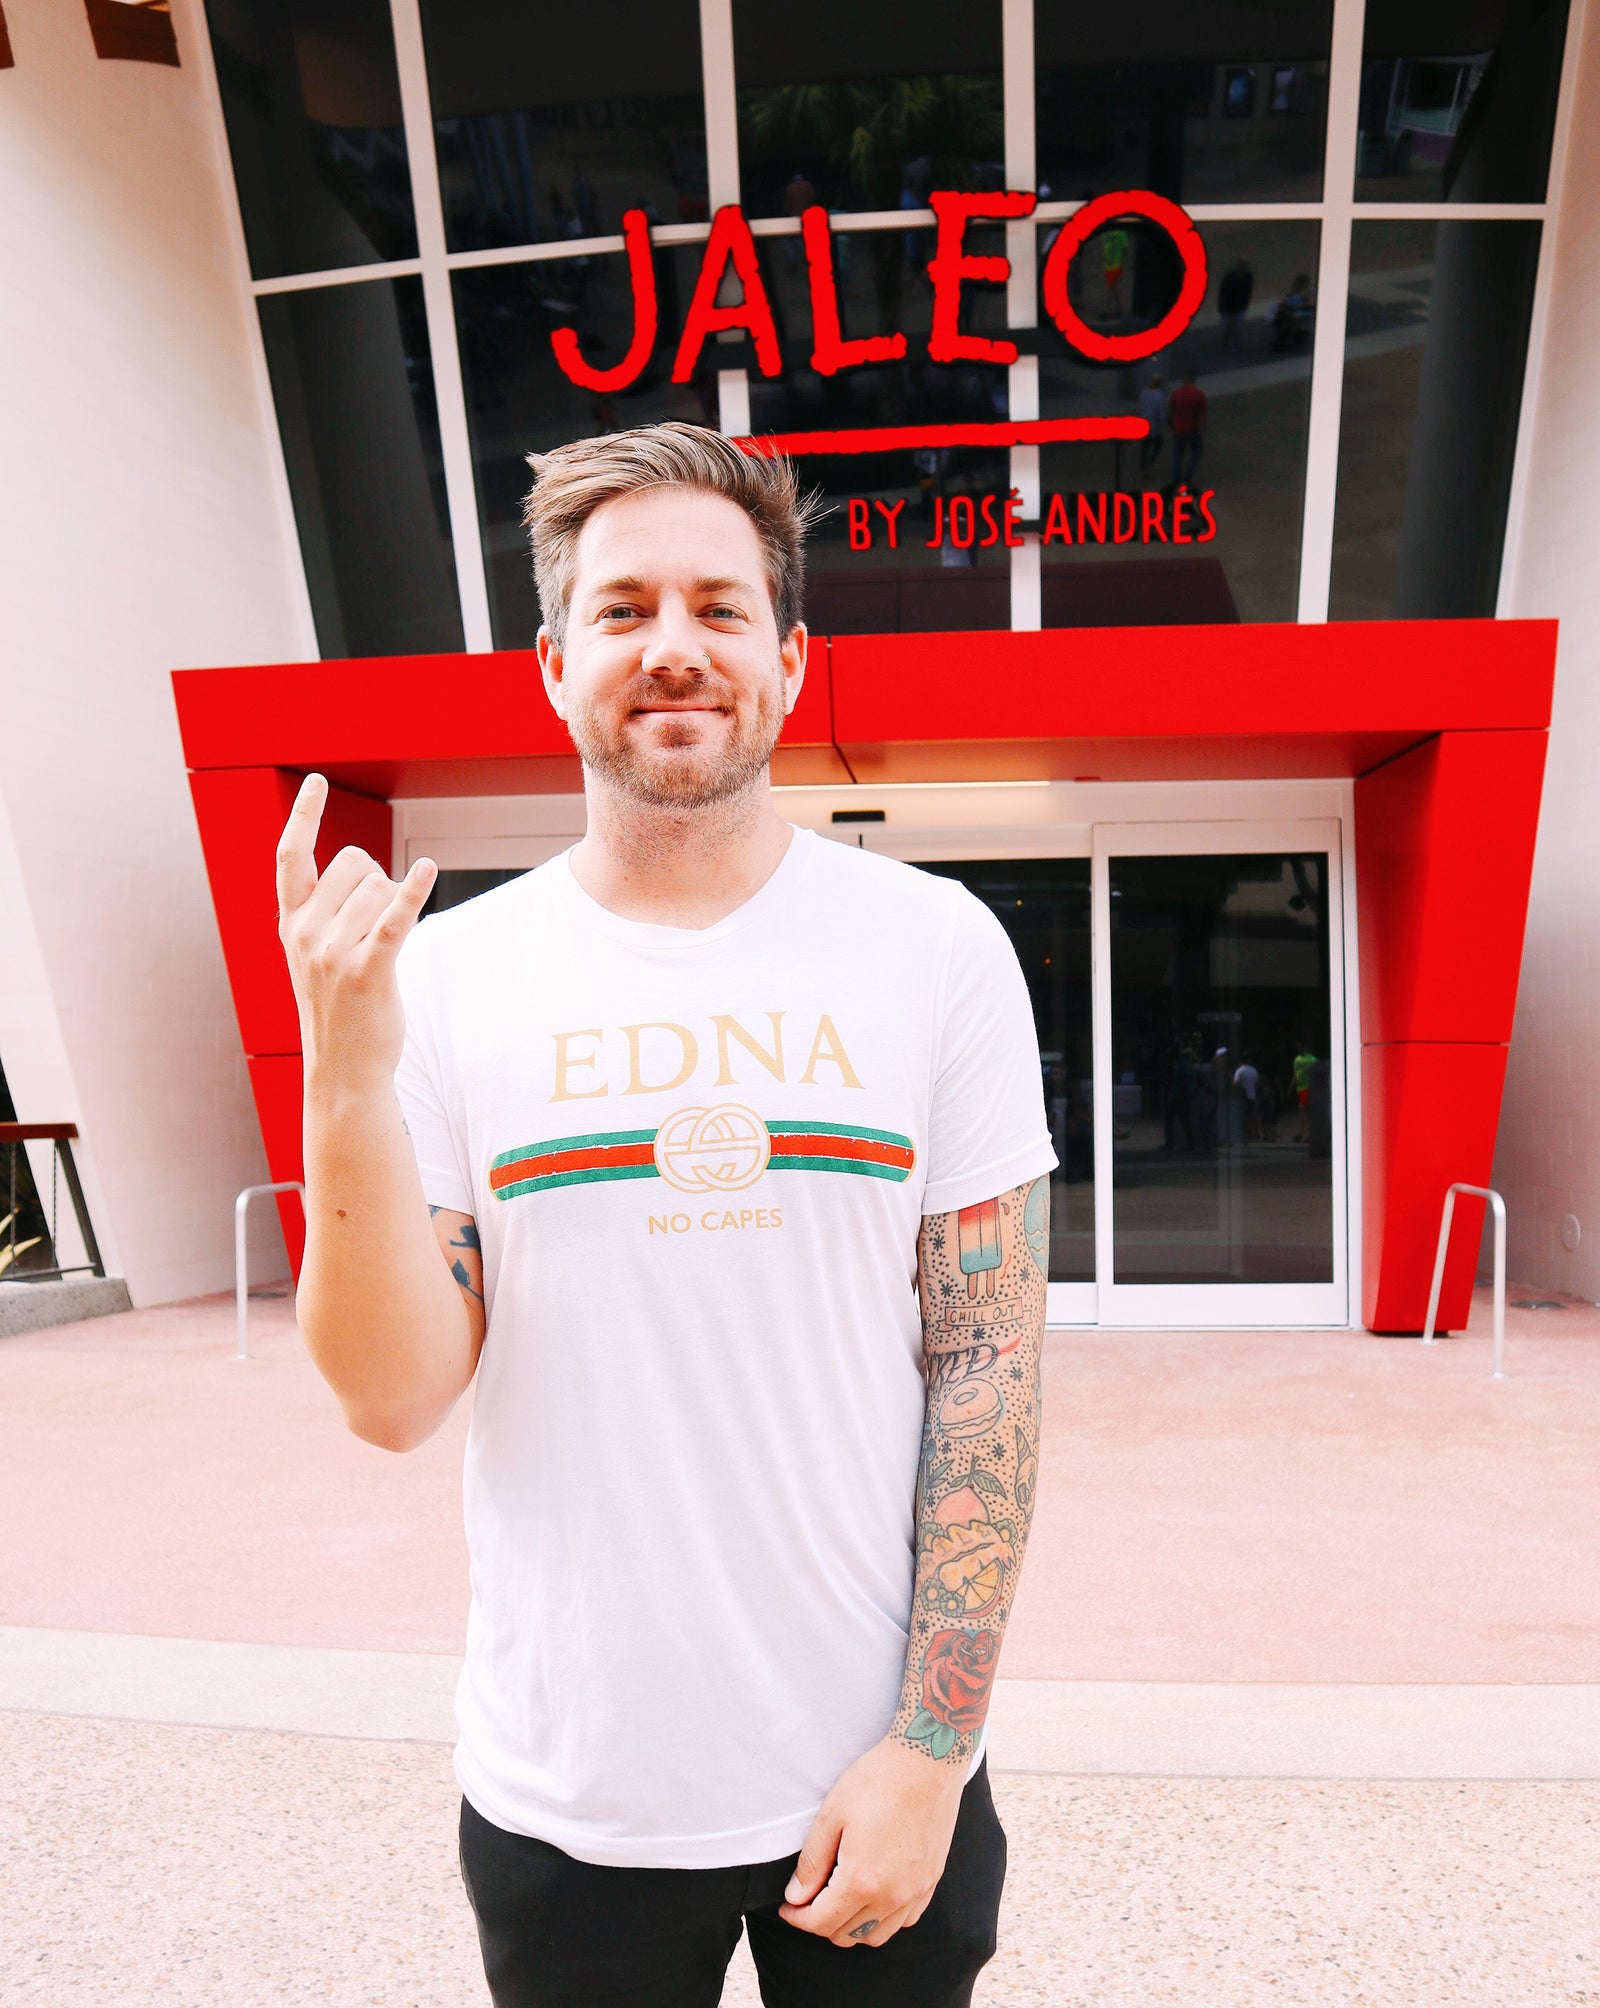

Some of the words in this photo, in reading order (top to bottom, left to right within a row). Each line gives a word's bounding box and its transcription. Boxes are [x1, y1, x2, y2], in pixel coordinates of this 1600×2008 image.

[550, 189, 1208, 393] JALEO
[848, 497, 905, 551] BY
[926, 488, 1025, 549] JOSÉ
[1043, 484, 1218, 546] ANDRÉS
[546, 1011, 866, 1104] EDNA
[647, 1213, 692, 1235] NO
[700, 1207, 783, 1232] CAPES
[949, 1310, 986, 1324] CHILL
[992, 1303, 1016, 1321] OUT
